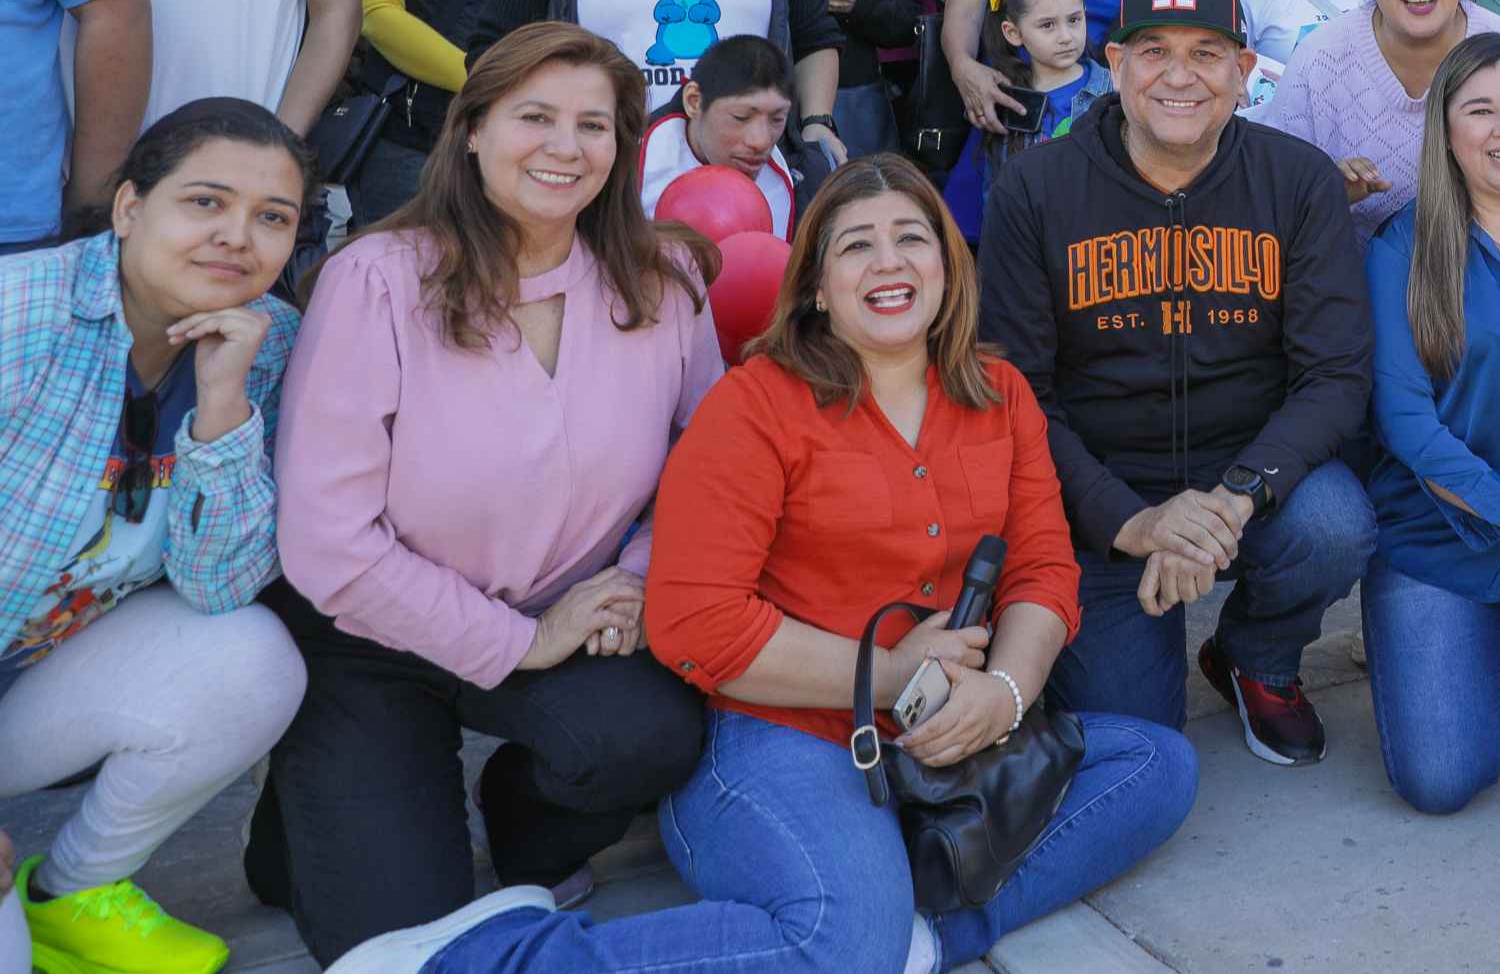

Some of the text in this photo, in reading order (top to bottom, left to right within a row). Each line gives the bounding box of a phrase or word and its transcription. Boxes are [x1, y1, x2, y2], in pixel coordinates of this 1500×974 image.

[1067, 224, 1281, 311] HERMOSILLO
[1097, 313, 1146, 330] EST.
[1207, 308, 1260, 325] 1958
